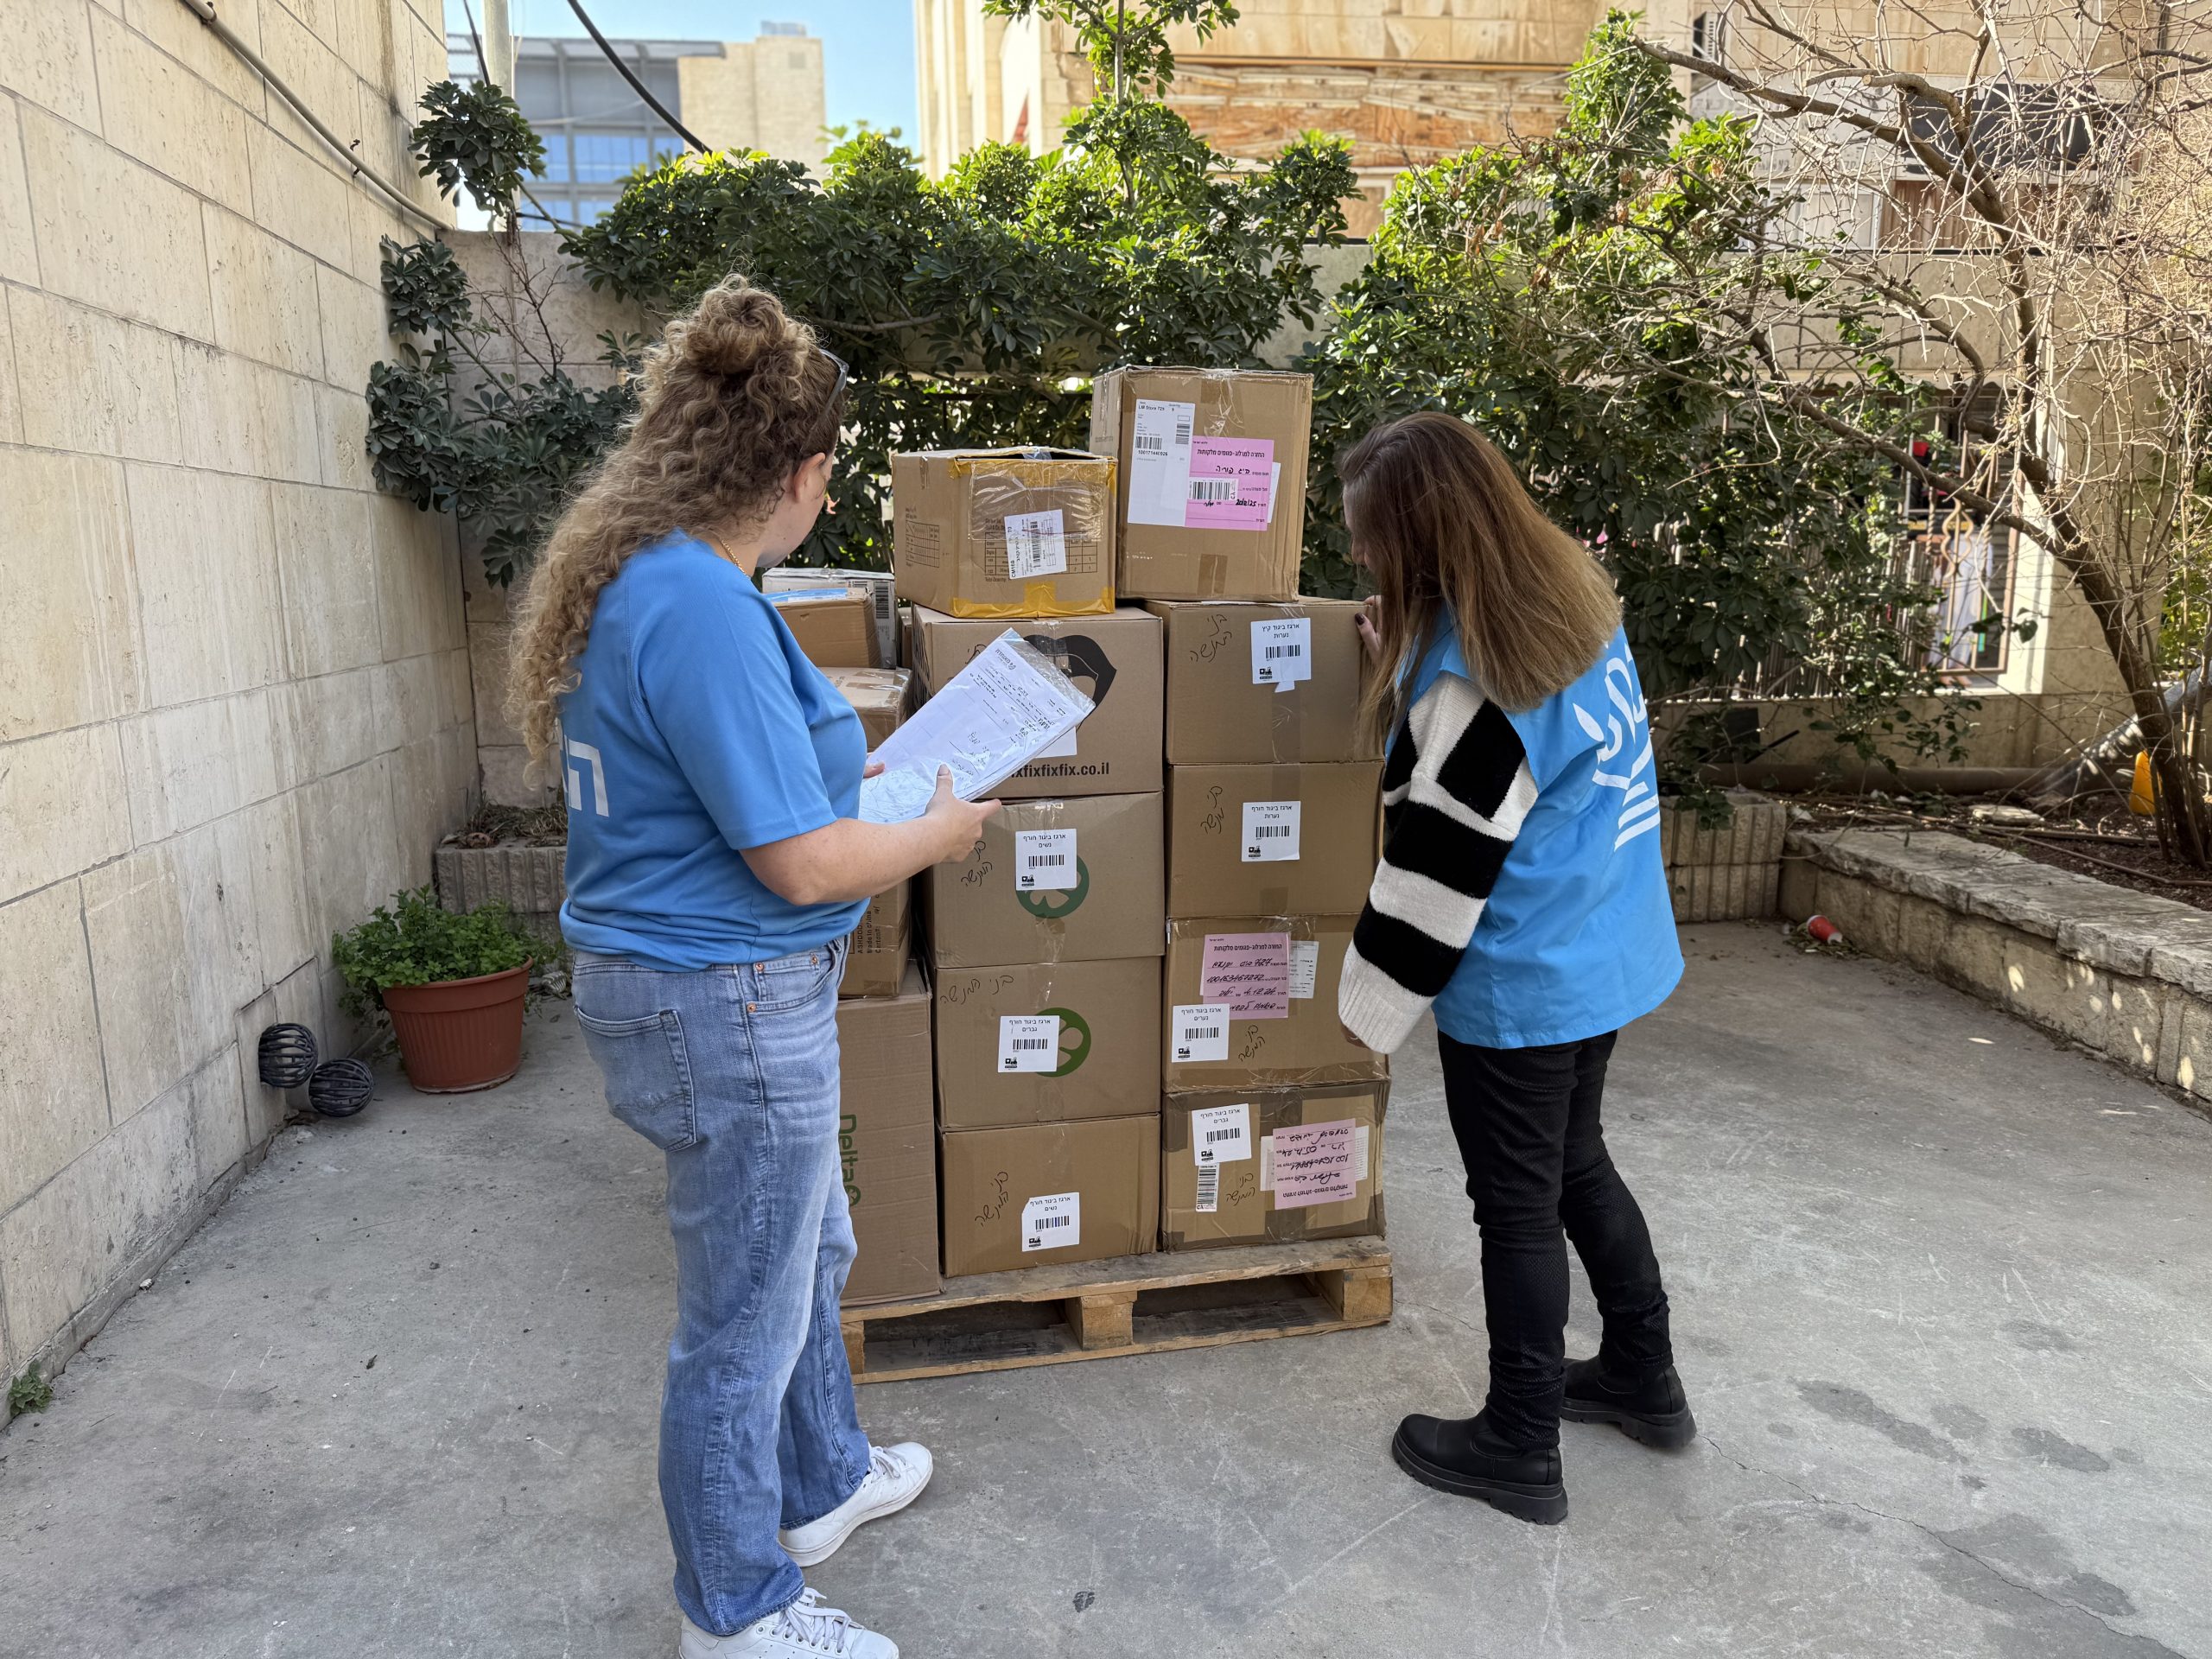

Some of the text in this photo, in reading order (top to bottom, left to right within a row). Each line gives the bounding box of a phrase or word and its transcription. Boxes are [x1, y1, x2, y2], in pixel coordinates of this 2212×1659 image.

[1206, 613, 1228, 637] בני
[1207, 785, 1224, 810] בני
[961, 861, 993, 887] המנשה
[940, 975, 1014, 1005] בני המנשה
[839, 1114, 858, 1182] Delta
[989, 1171, 1009, 1193] בני
[1238, 1173, 1255, 1188] בני
[1225, 1186, 1255, 1206] המנשה
[975, 1191, 1010, 1228] המנשה
